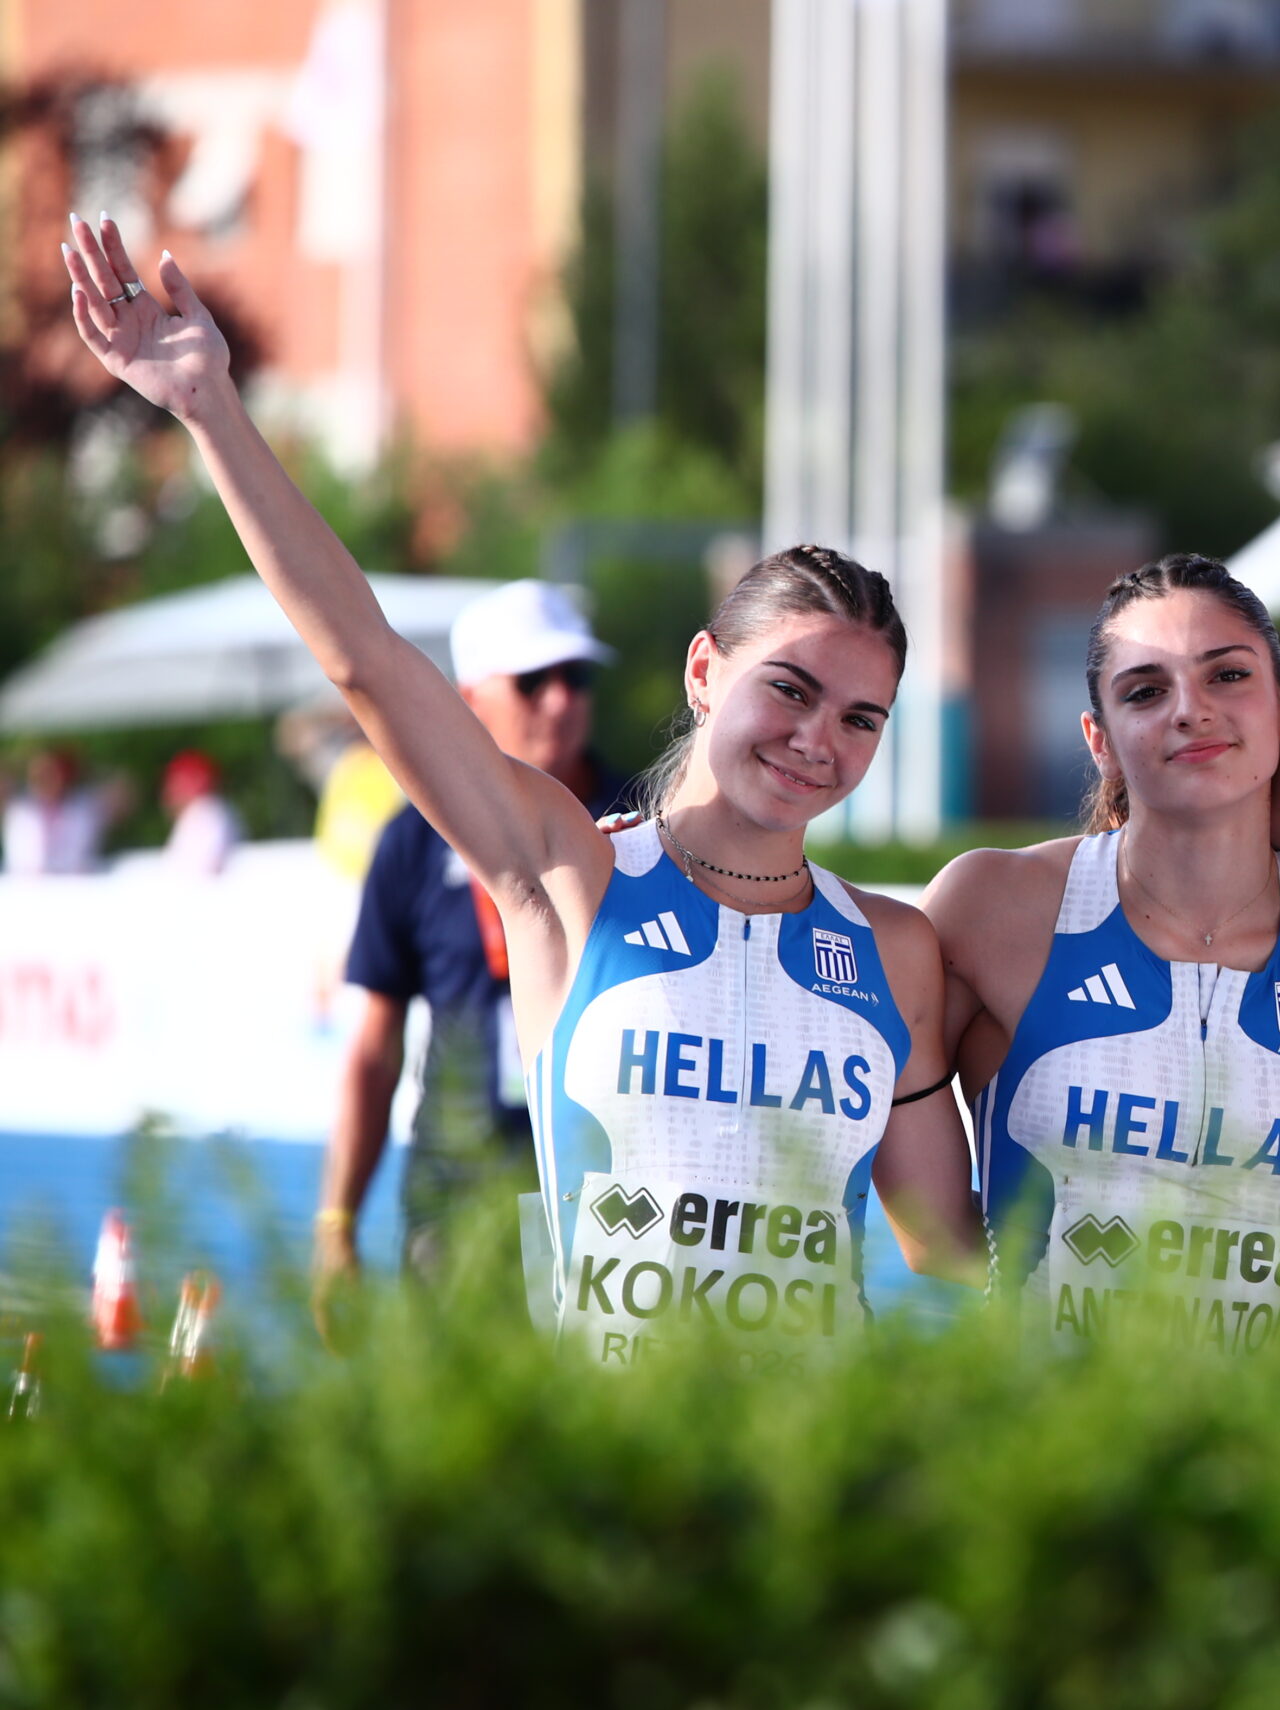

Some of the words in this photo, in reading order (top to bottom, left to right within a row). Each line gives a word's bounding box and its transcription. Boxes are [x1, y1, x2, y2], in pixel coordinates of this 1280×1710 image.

[811, 983, 869, 1002] AEGEAN
[617, 1029, 872, 1121] HELLAS
[576, 1254, 836, 1337] KOKOSI
